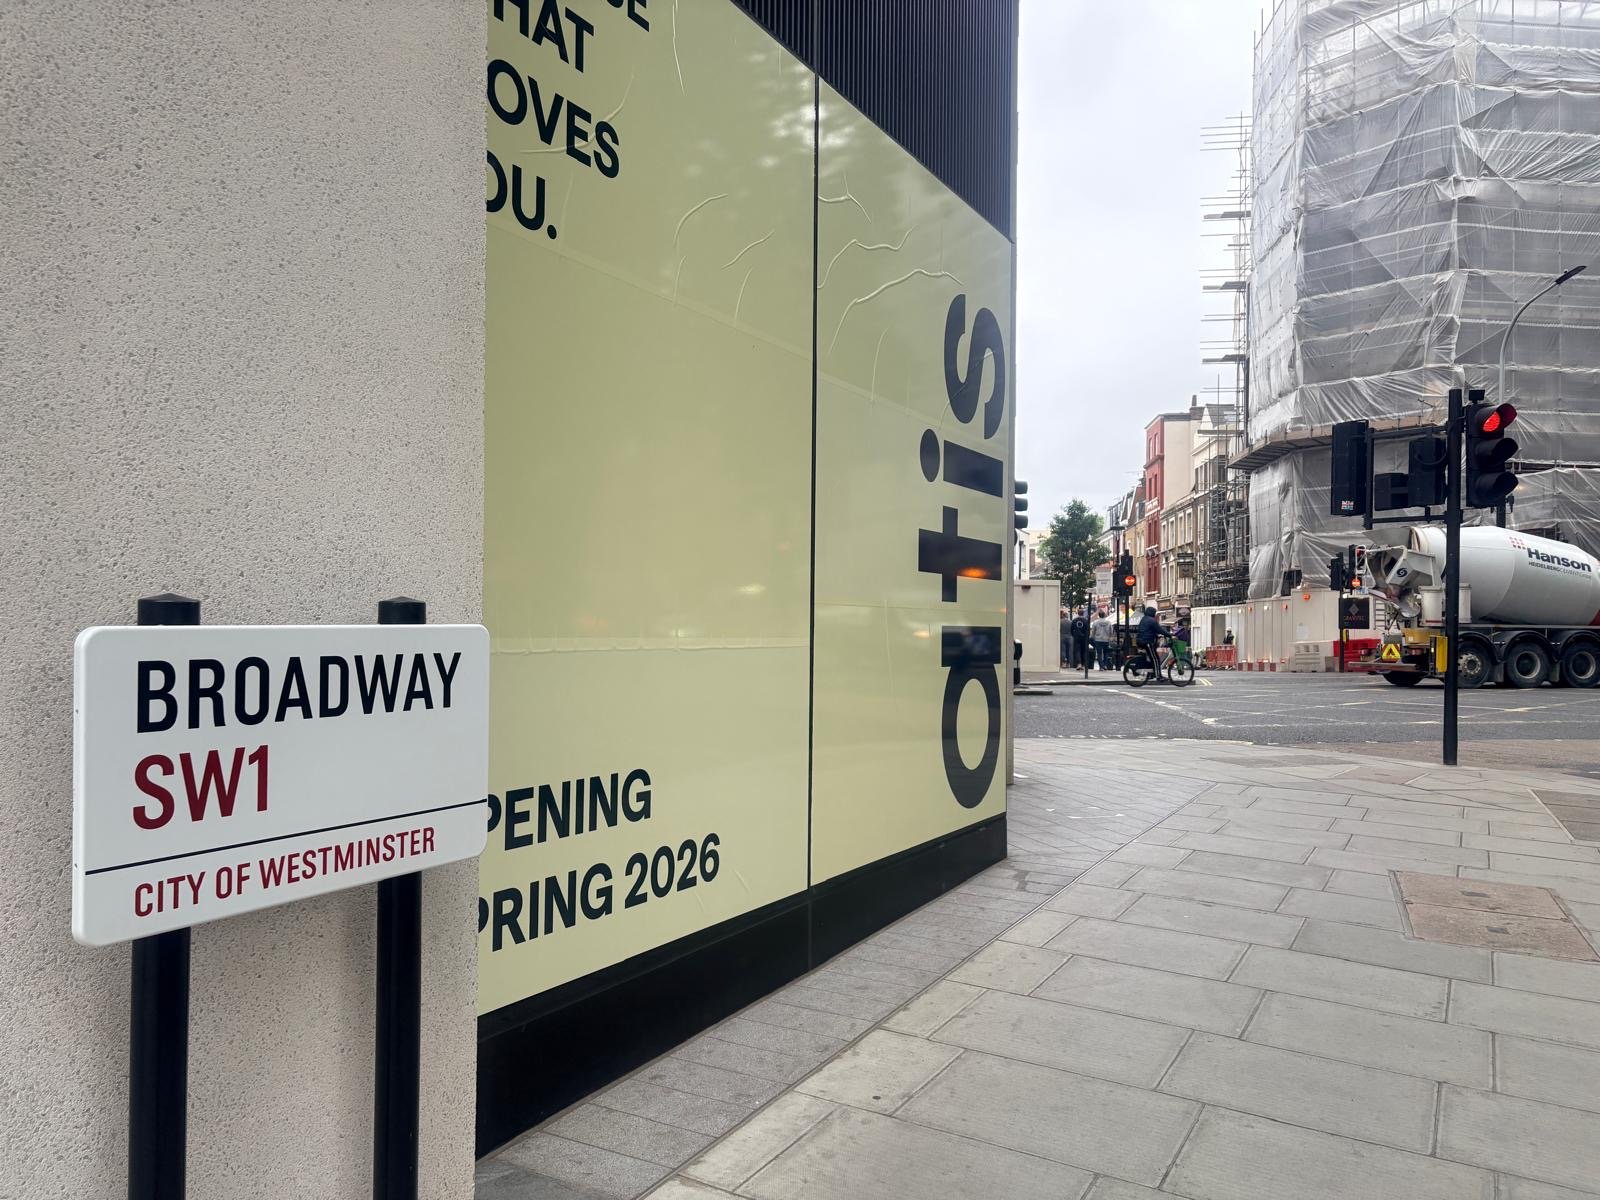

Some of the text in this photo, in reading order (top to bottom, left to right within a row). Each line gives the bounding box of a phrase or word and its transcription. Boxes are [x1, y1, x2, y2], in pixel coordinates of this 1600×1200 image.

[487, 59, 620, 179] OVES
[1527, 547, 1592, 573] Hanson
[137, 652, 462, 734] BROADWAY
[132, 744, 269, 830] SW1
[134, 826, 436, 917] CITY OF WESTMINSTER
[624, 832, 721, 910] 2026
